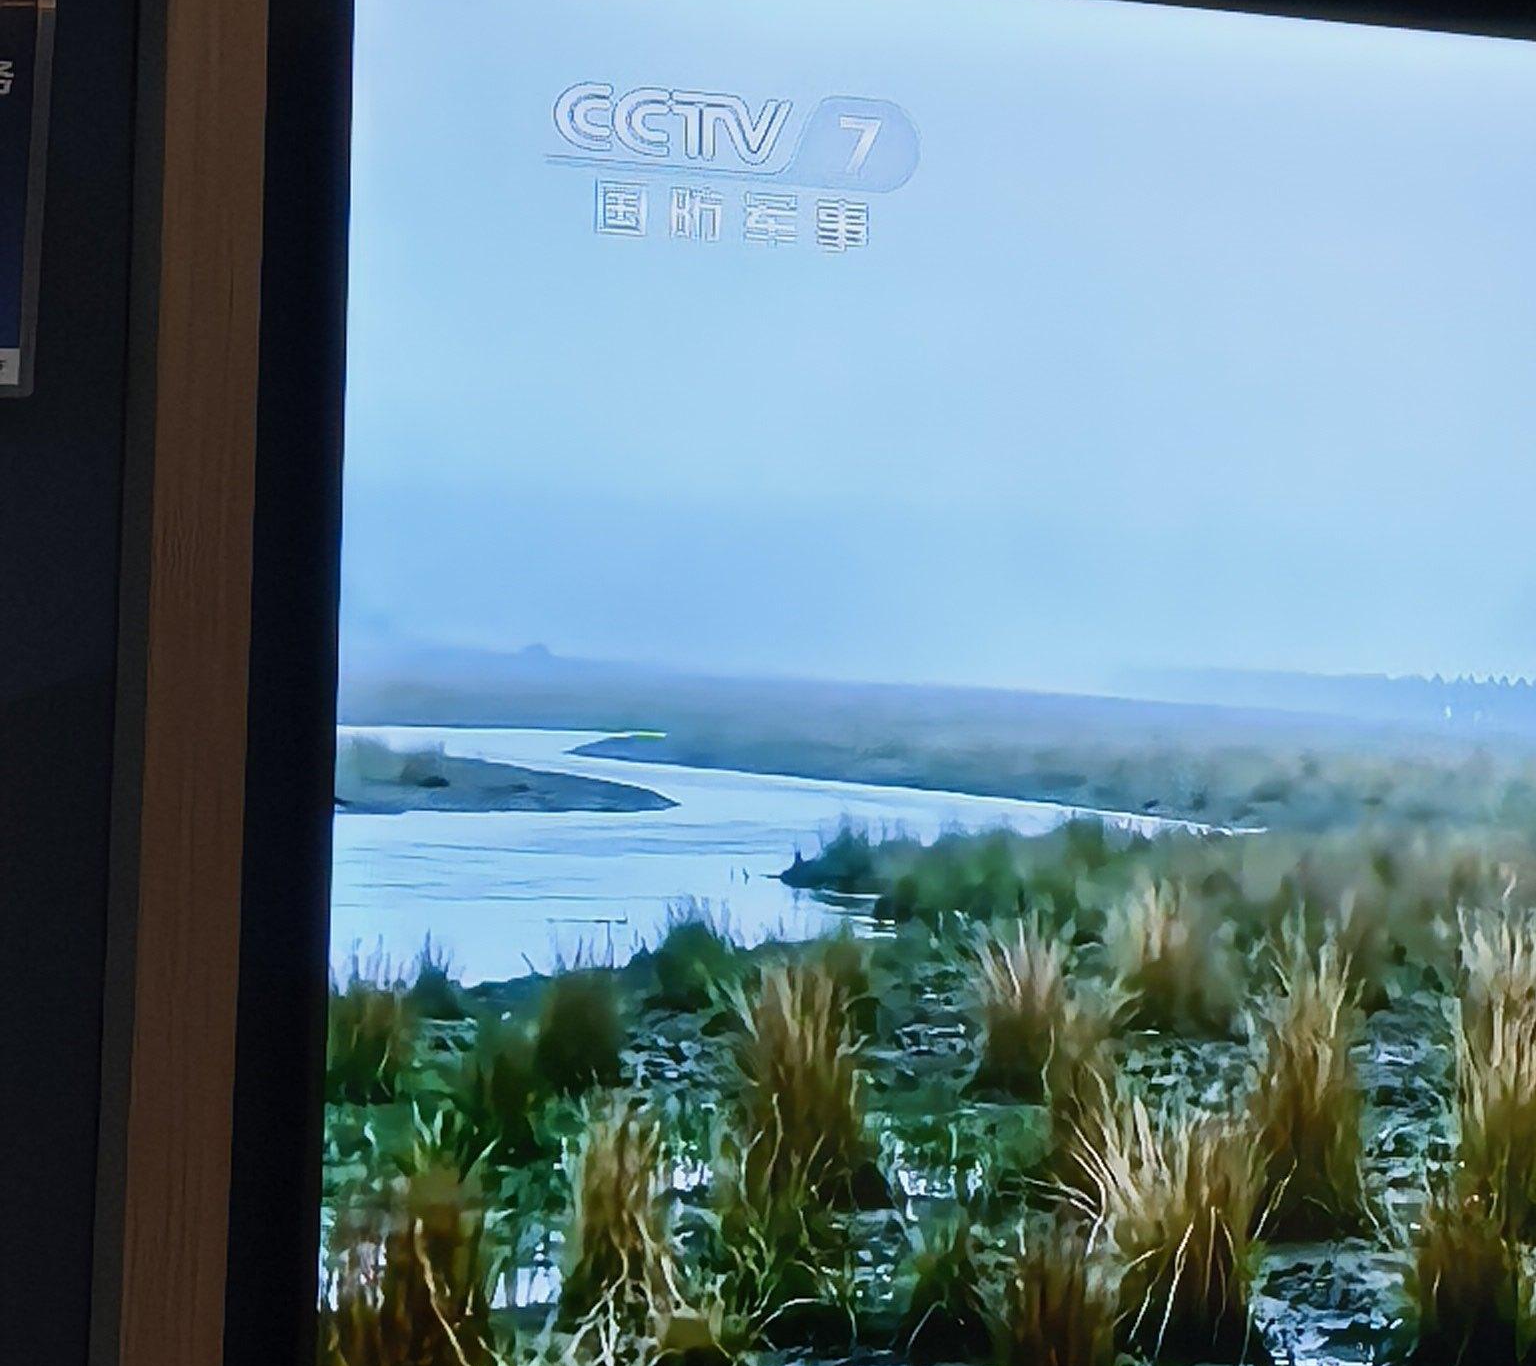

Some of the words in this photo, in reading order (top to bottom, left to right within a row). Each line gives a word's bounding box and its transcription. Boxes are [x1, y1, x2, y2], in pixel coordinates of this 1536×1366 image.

[553, 81, 793, 165] CCTV
[838, 115, 884, 179] 7
[594, 180, 870, 253] 国防军事
